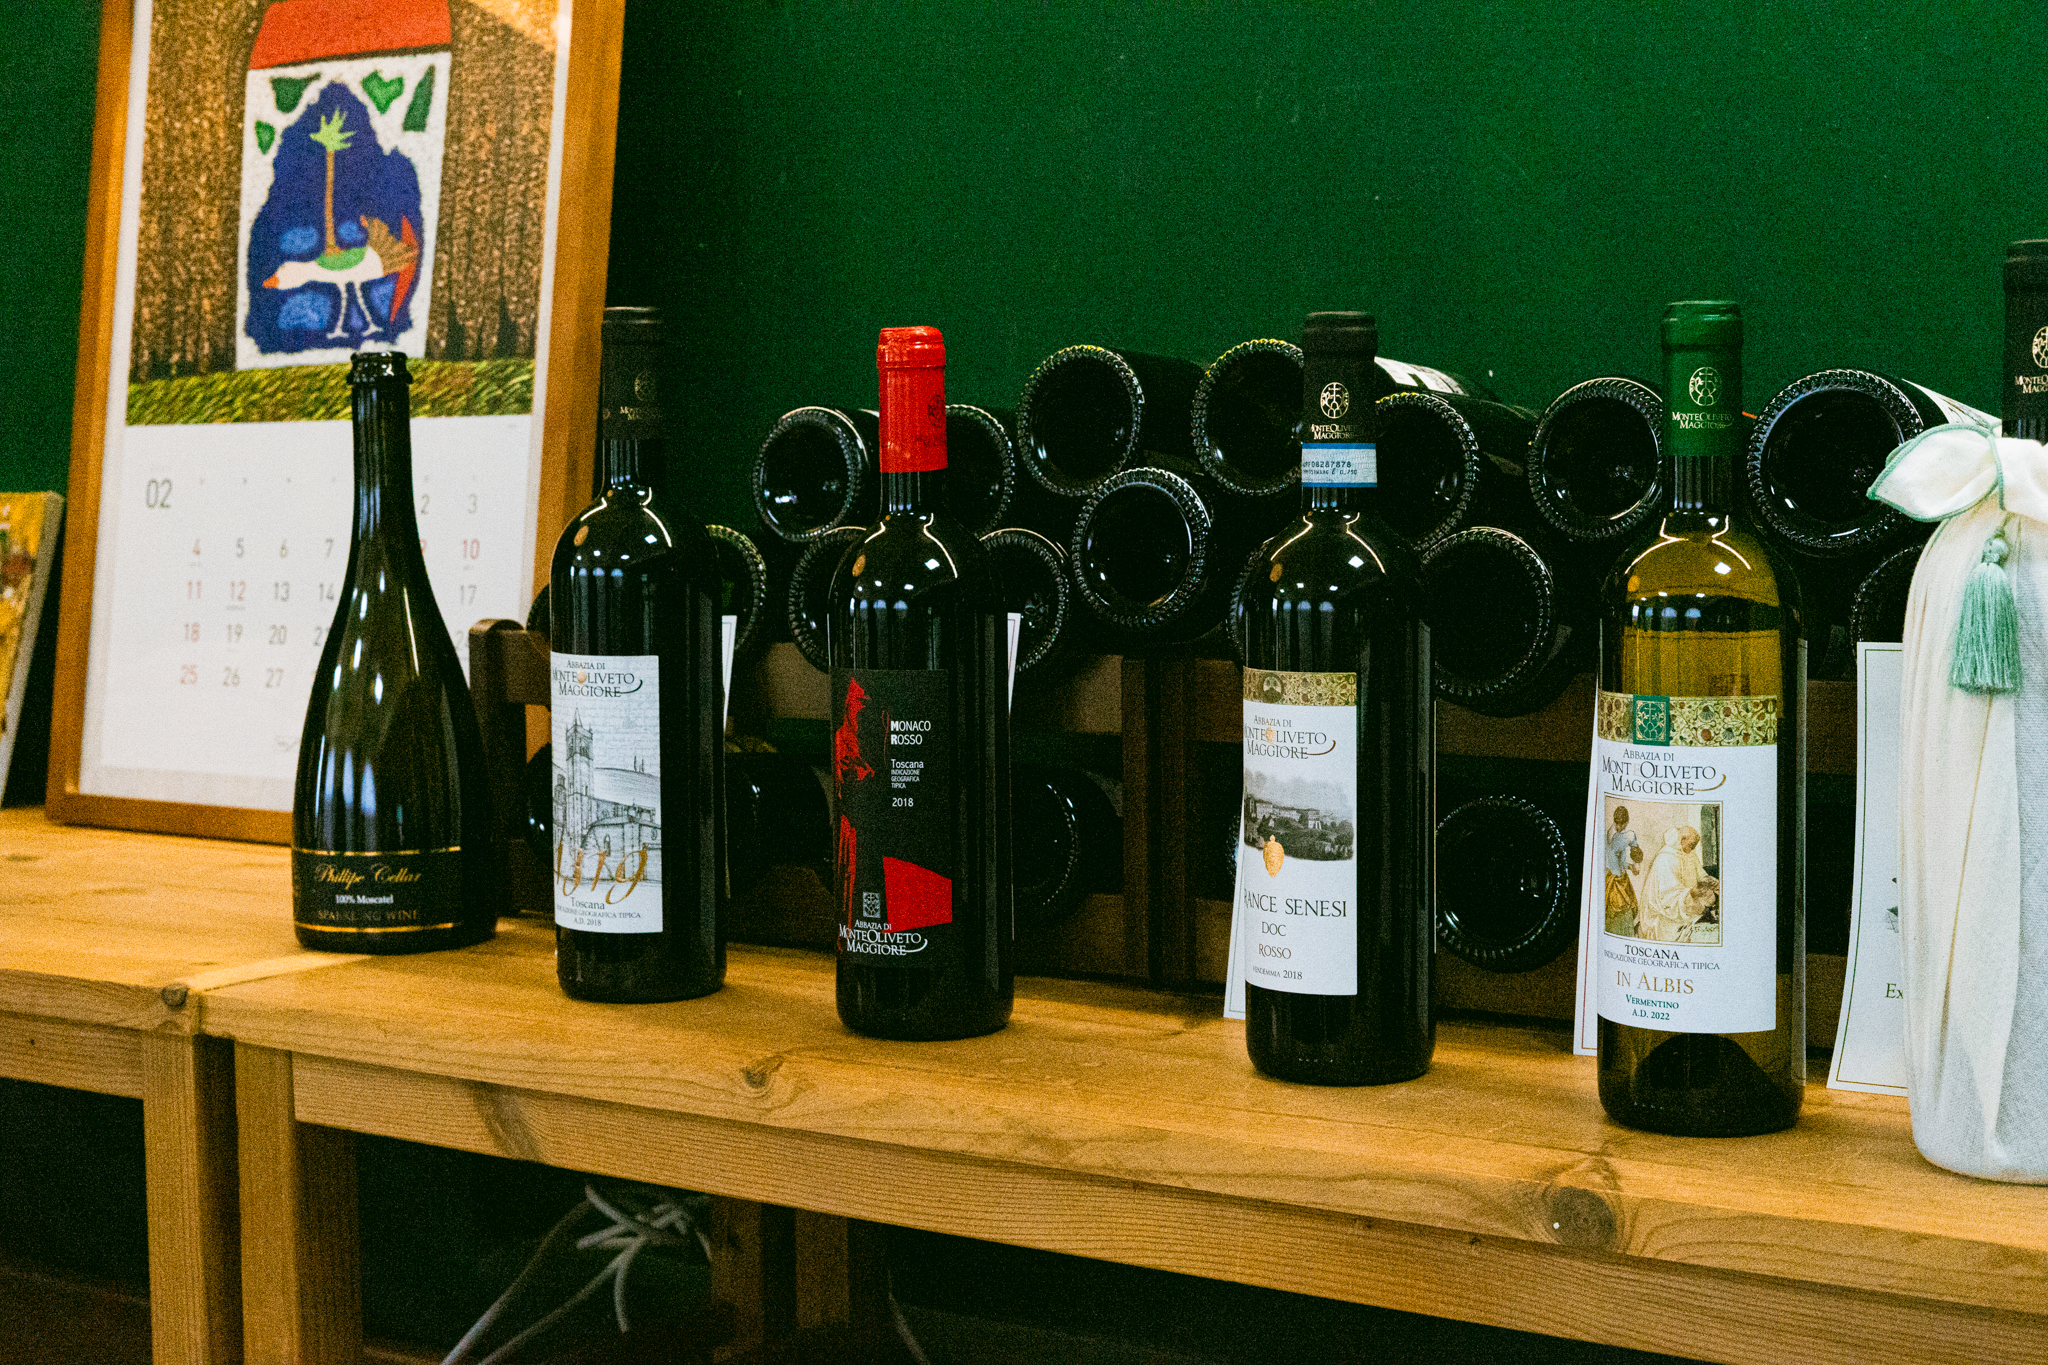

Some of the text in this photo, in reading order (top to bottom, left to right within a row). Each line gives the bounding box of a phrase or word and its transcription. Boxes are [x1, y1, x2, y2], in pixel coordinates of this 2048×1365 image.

[146, 478, 173, 509] 02
[420, 493, 478, 515] 2 3
[236, 537, 245, 559] 5
[279, 537, 288, 559] 6
[325, 537, 334, 558] 7
[463, 538, 480, 560] 10
[187, 580, 478, 606] 11 12 13 14 17
[184, 622, 201, 642] 18
[227, 623, 244, 643] 19
[268, 624, 287, 645] 20
[180, 664, 285, 688] 25 26 27
[559, 681, 621, 698] MAGGIORE
[890, 721, 931, 732] MONACO
[1282, 719, 1292, 728] DI
[890, 734, 923, 745] ROSSO
[1247, 739, 1309, 760] MAGGIORE
[1623, 748, 1674, 761] ABBAZIA DI
[891, 758, 924, 769] Toscana
[1612, 774, 1695, 796] MAGGIORE
[892, 797, 914, 807] 2018
[335, 893, 356, 904] 100%
[571, 897, 605, 910] Toscana
[1285, 898, 1347, 917] SENESI
[855, 919, 882, 930] ABBAZIA
[1261, 921, 1287, 936] DOC
[839, 923, 922, 944] MONTEOLIVETO
[847, 938, 907, 956] MAGGIORE
[1258, 943, 1292, 959] ROSSO
[1625, 944, 1680, 960] TOSCANA
[1637, 957, 1689, 969] GEOGRAFICA
[1691, 962, 1720, 970] TIPICA
[1283, 969, 1303, 980] 2018
[1617, 970, 1694, 995] IN ALBIS
[1626, 994, 1679, 1009] VERMENTINO
[1632, 1009, 1670, 1020] A.D. 2022
